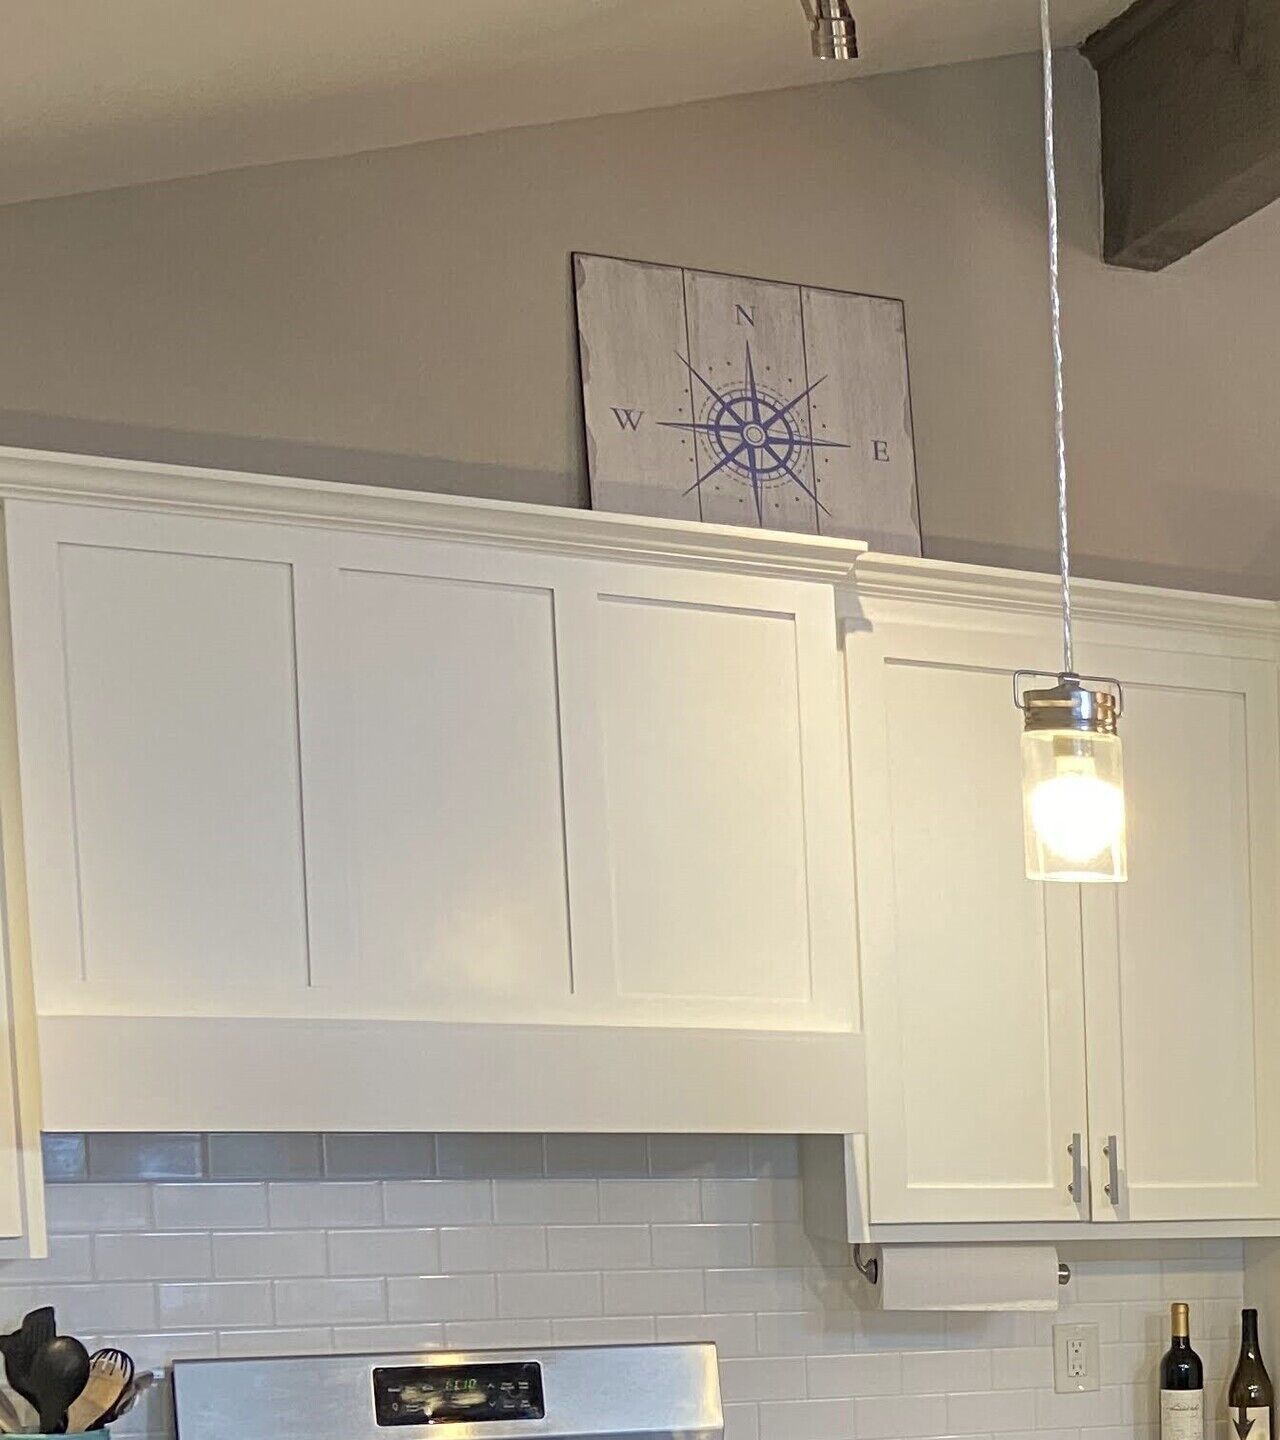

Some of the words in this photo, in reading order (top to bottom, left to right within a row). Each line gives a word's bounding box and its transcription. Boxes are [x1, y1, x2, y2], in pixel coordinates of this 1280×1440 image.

[733, 303, 756, 328] N
[609, 406, 645, 431] W
[871, 439, 890, 463] E
